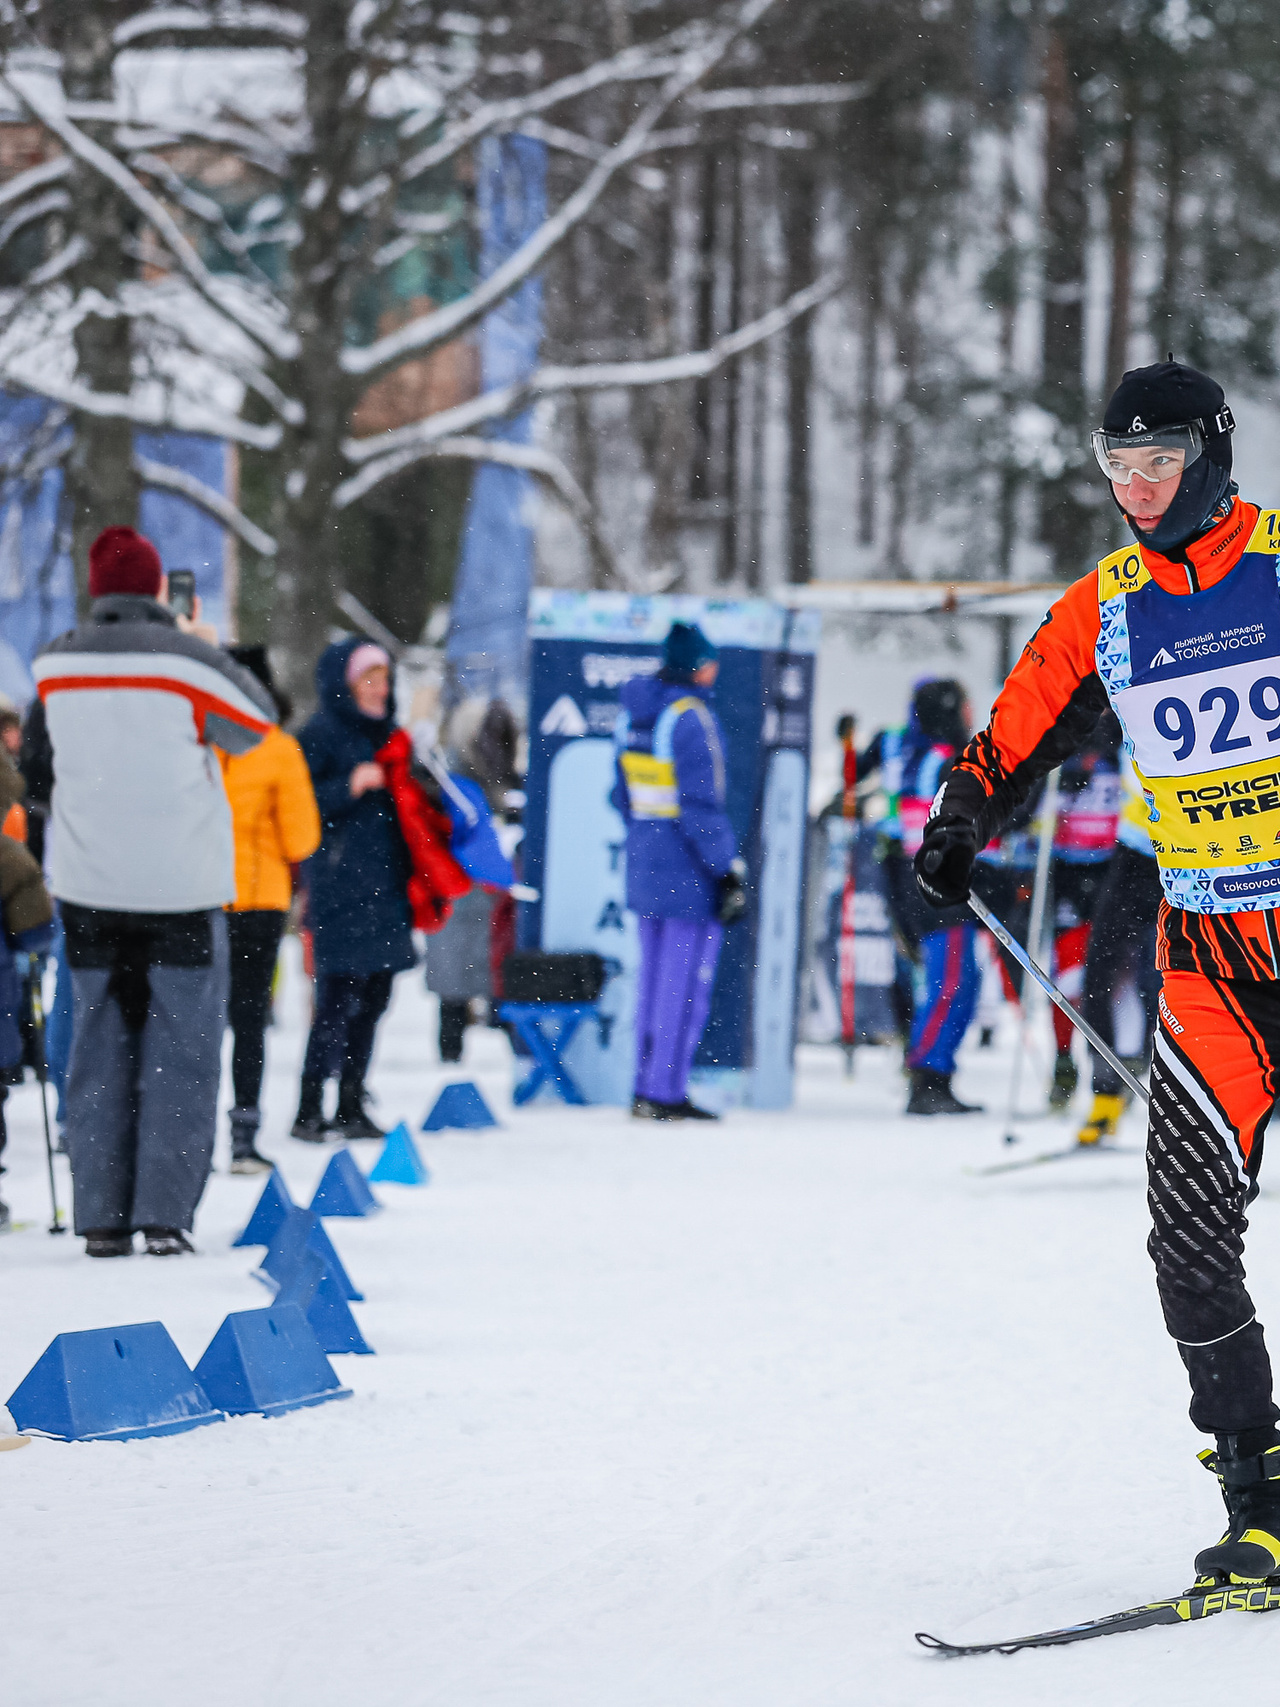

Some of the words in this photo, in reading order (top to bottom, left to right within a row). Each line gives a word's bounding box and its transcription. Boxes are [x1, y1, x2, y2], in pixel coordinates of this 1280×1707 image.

[1107, 553, 1141, 581] 10
[1174, 632, 1214, 650] ЛЫЖНЫЙ
[1220, 623, 1264, 639] МАРАФОН
[1175, 632, 1267, 661] TOKSOVOCUP
[597, 842, 625, 1049] ТАРТ
